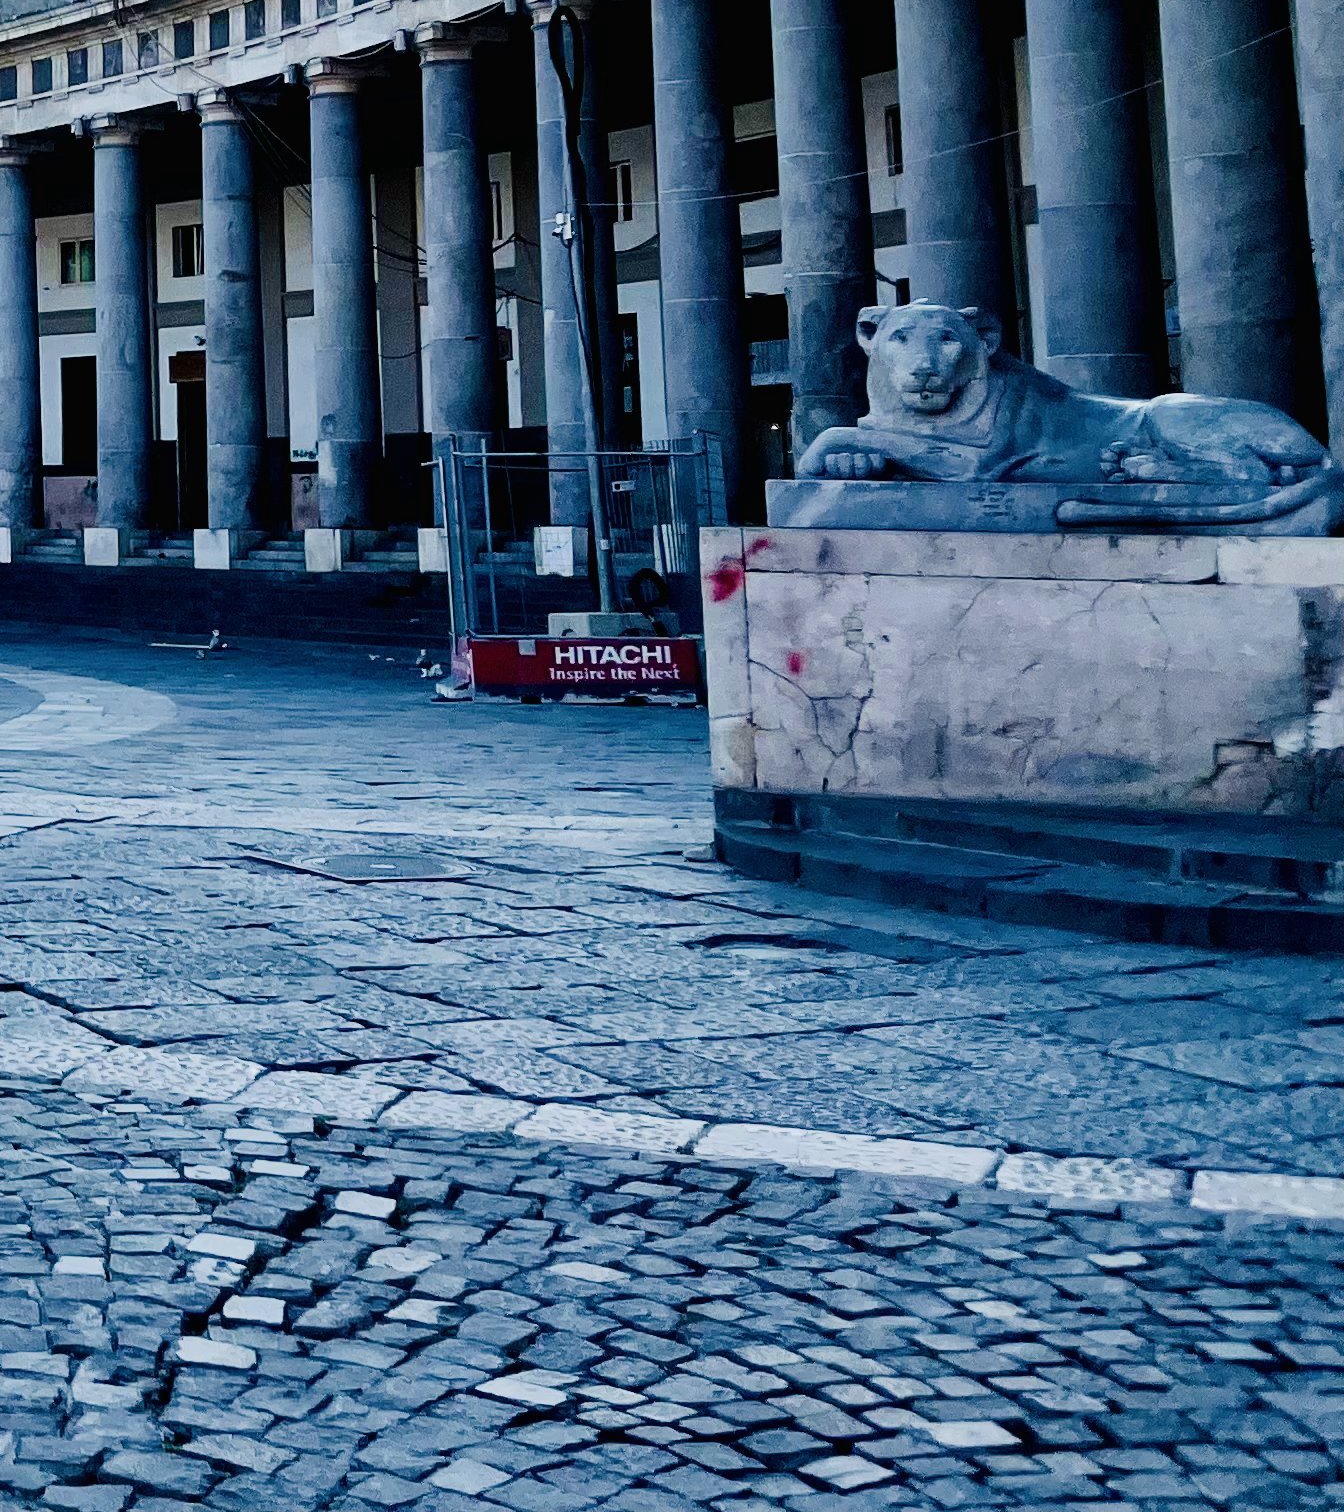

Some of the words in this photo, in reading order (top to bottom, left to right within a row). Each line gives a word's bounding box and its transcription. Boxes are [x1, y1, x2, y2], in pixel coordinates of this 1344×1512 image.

[554, 645, 672, 665] HITACHI
[549, 667, 606, 683] Inspire
[611, 667, 637, 680] the
[641, 664, 681, 680] Next
